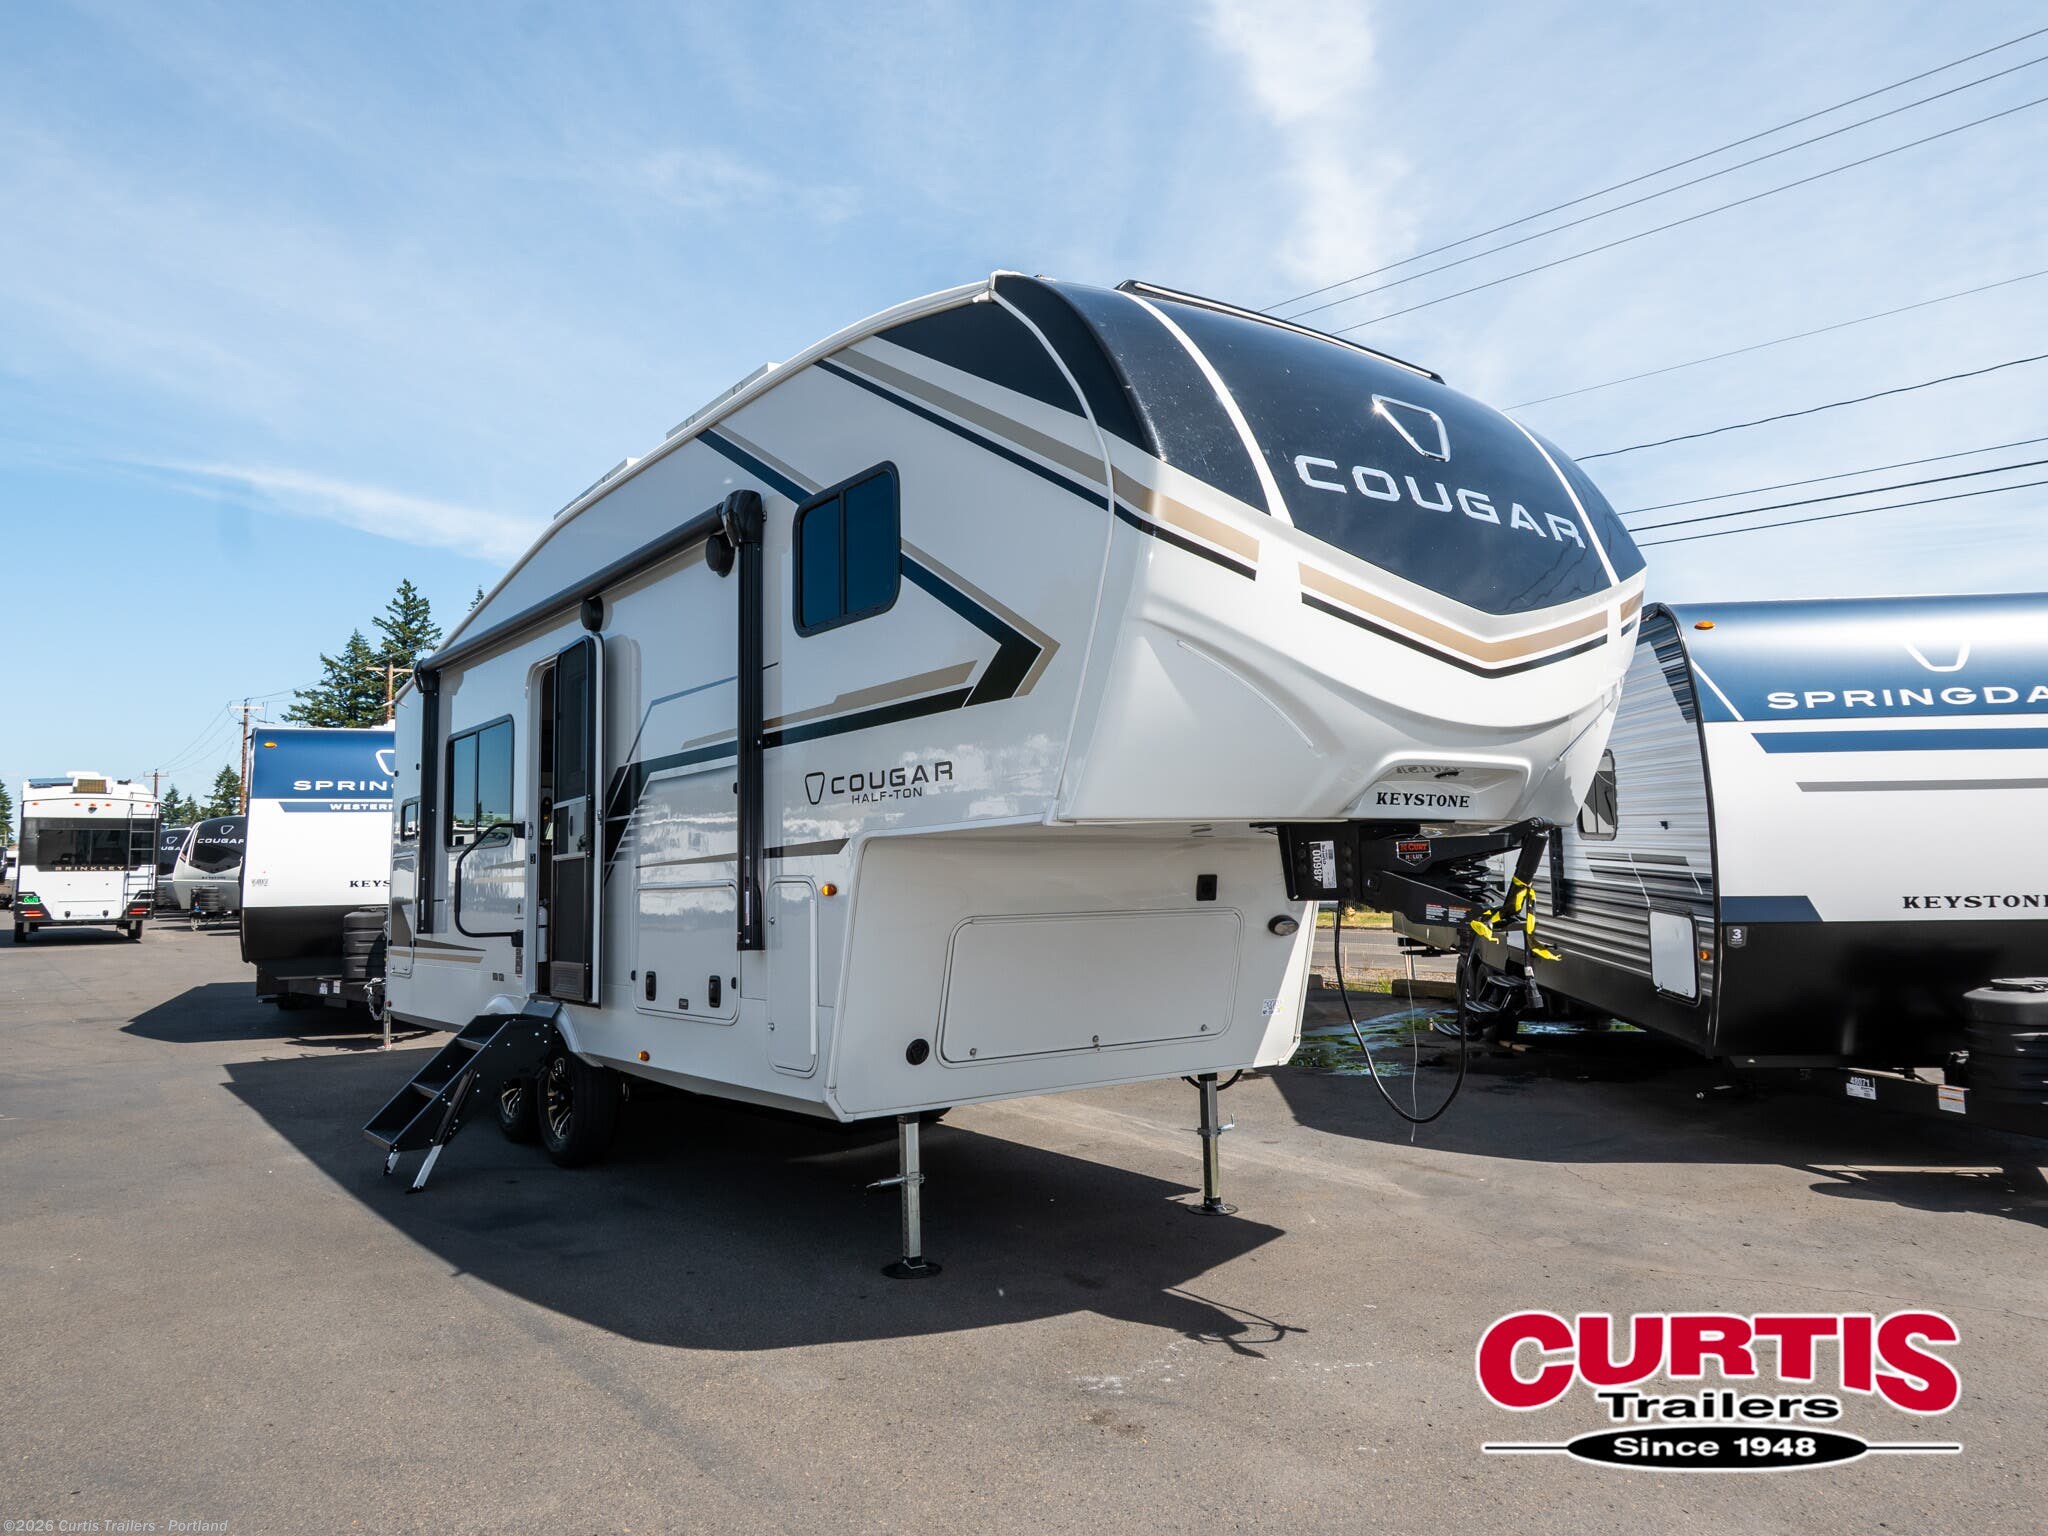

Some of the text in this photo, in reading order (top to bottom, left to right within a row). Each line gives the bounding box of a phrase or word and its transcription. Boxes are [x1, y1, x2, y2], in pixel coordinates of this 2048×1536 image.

[1295, 455, 1587, 549] COUGAR
[293, 780, 394, 791] SPRIN
[831, 761, 953, 794] COUGAR
[851, 787, 923, 804] HALF-TON
[1376, 791, 1470, 808] KEYSTONE
[1312, 849, 1323, 882] 48600
[1732, 928, 1742, 939] 3
